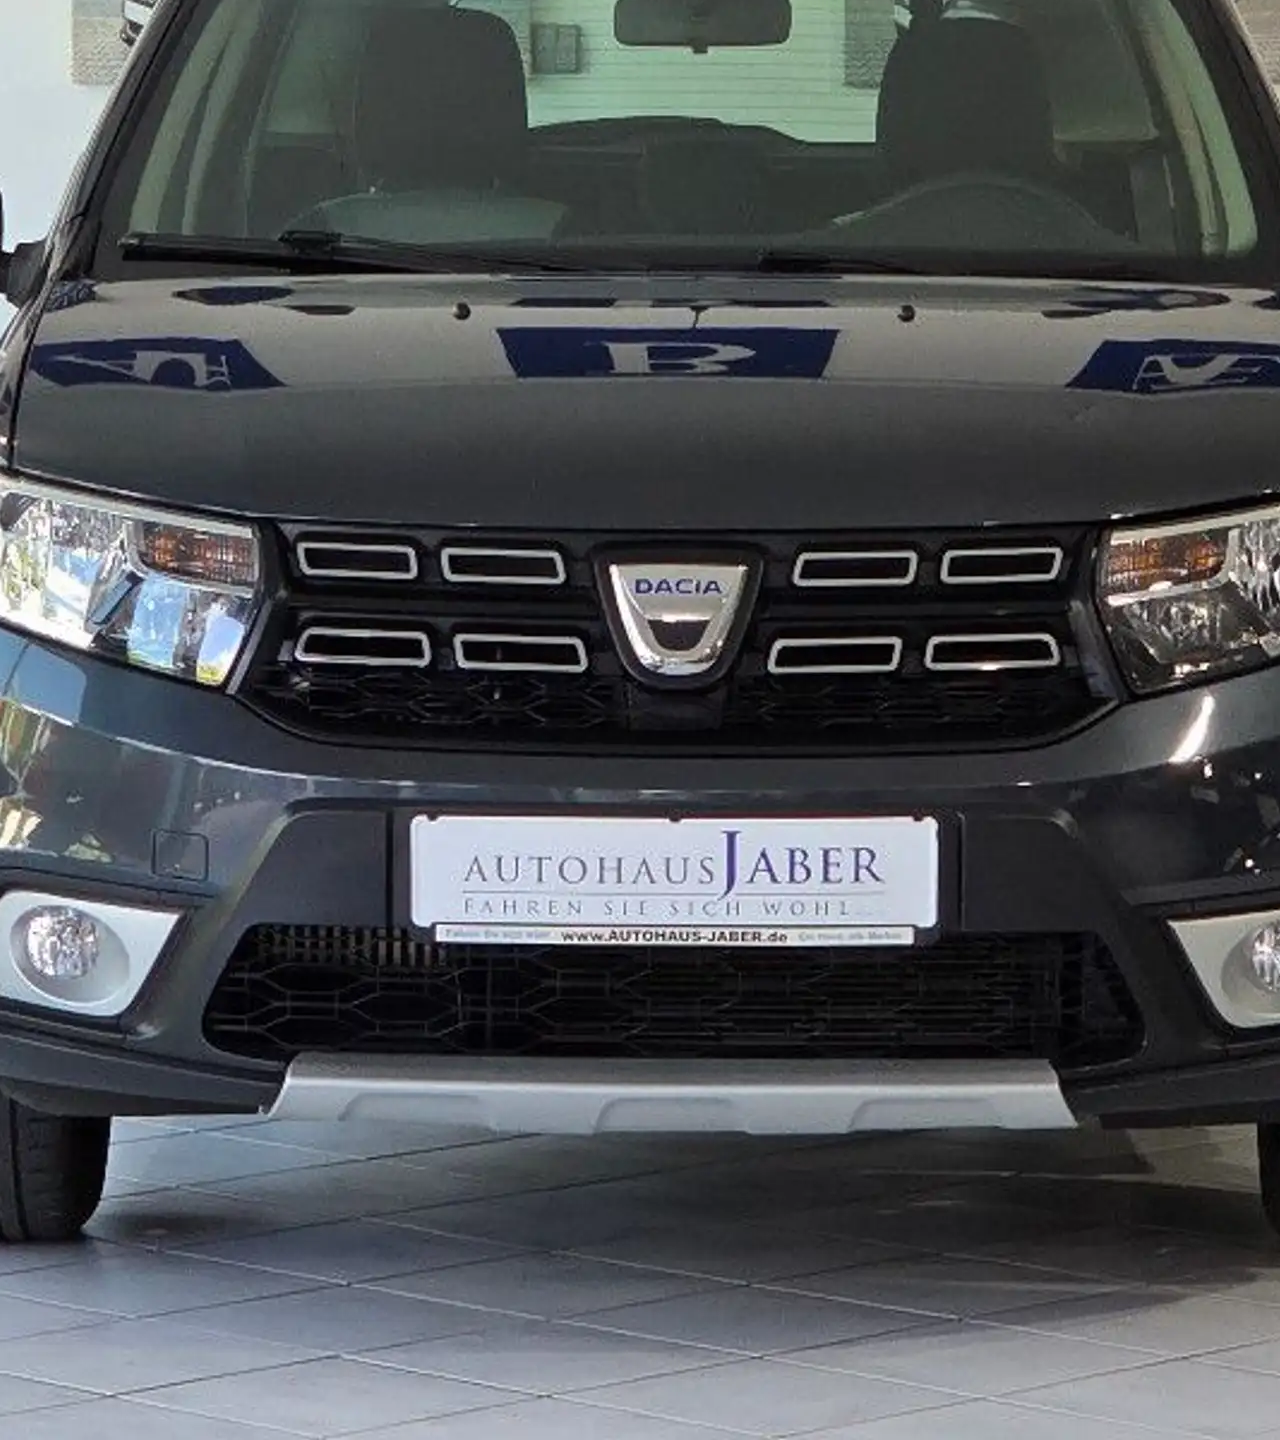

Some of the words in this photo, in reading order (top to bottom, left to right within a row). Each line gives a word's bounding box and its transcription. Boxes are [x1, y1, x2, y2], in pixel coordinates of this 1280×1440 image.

[634, 578, 723, 595] DACIA
[464, 898, 582, 917] FAHREN
[604, 900, 648, 916] SIE
[669, 900, 741, 917] SICH
[560, 929, 788, 944] www.AUTOHAUS-JABER.de
